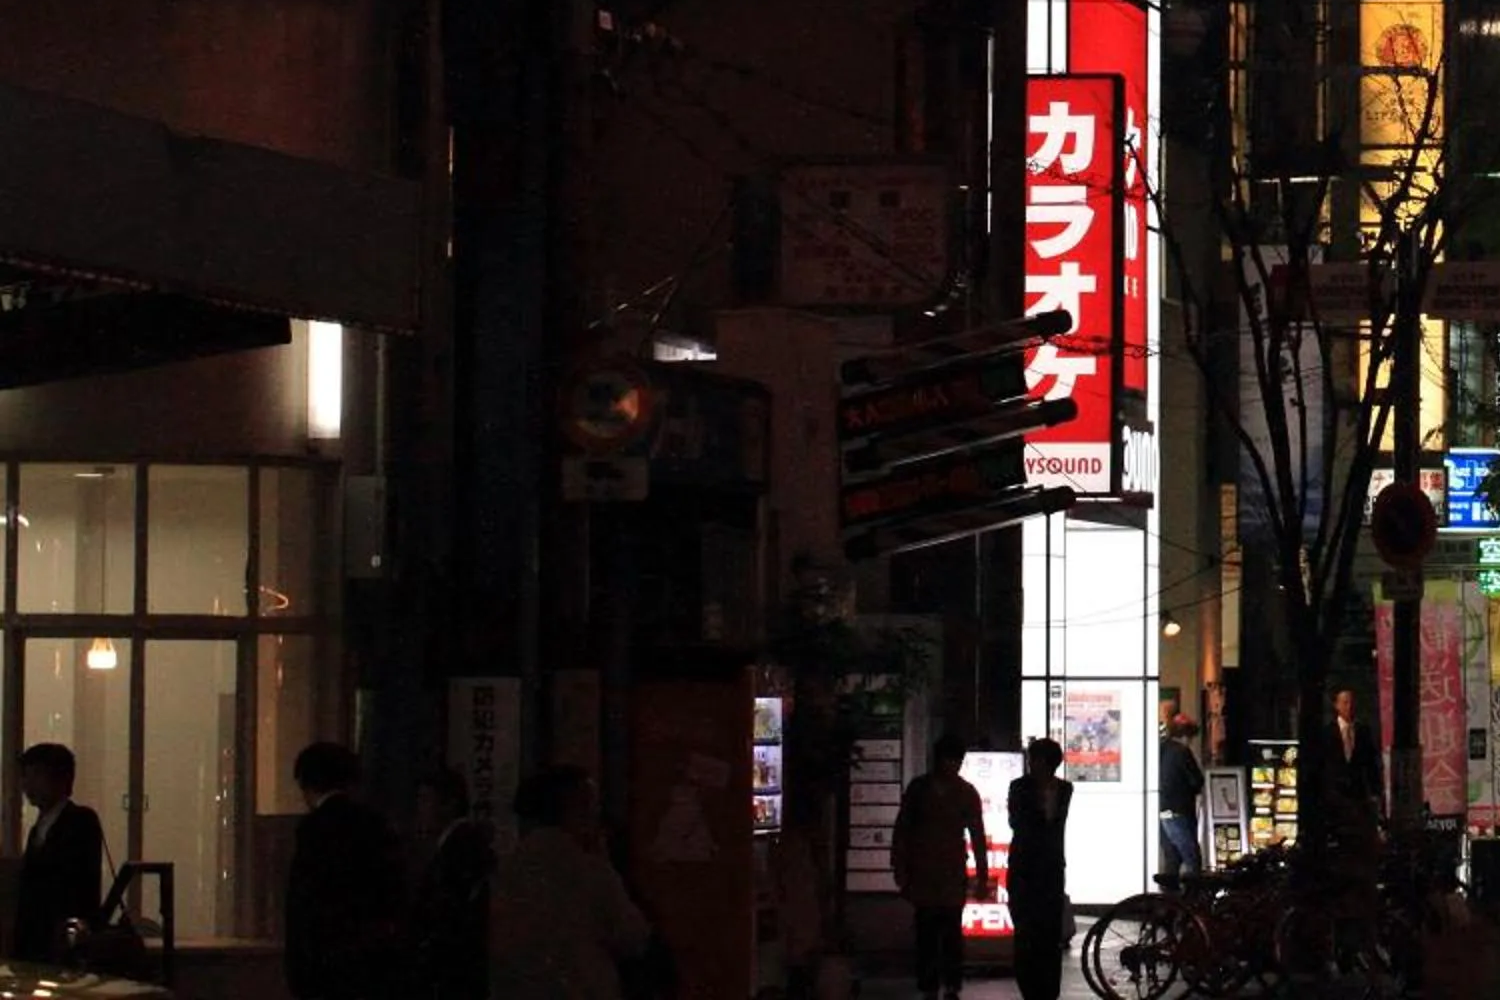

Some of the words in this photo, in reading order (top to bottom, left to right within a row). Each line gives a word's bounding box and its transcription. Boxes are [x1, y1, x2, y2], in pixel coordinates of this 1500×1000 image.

[1025, 101, 1097, 401] カラオケ
[1026, 456, 1103, 476] YSOUND
[962, 903, 1013, 933] PEN
